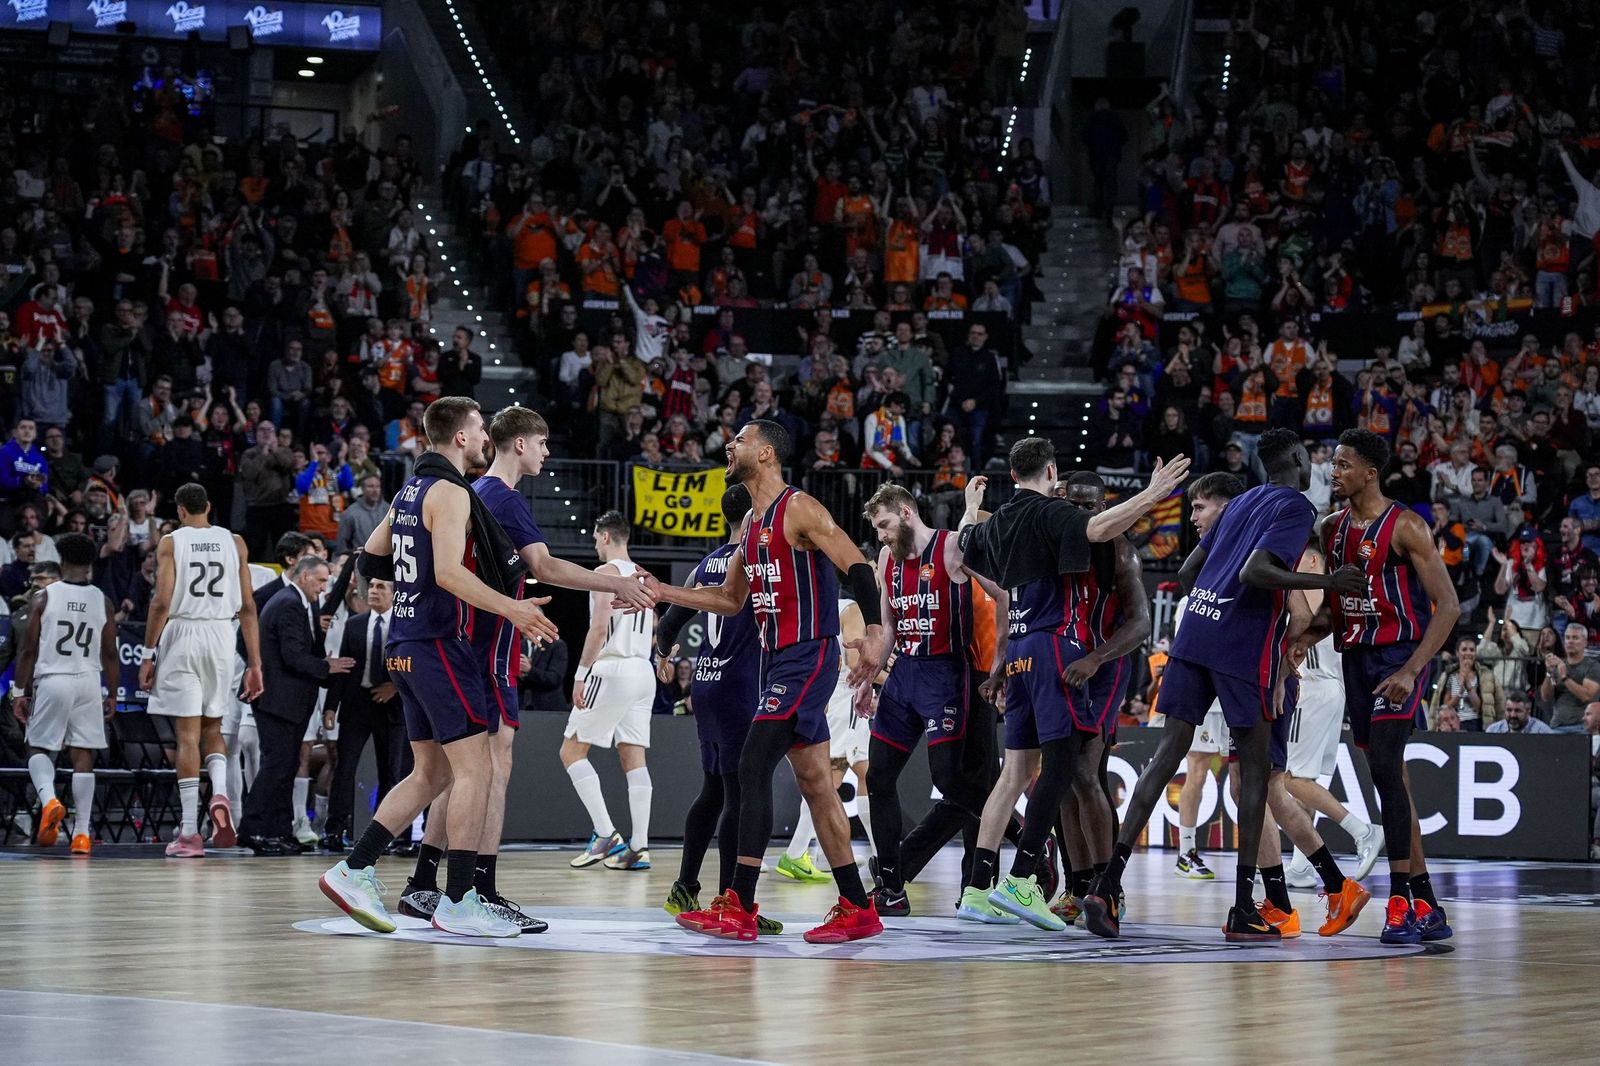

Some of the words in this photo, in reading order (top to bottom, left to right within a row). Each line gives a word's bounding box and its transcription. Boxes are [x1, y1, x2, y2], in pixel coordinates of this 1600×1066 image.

[652, 474, 707, 492] LIM
[640, 509, 721, 532] HOME
[190, 543, 221, 553] TAVARES
[705, 557, 730, 573] HOW
[189, 561, 225, 598] 22
[751, 592, 779, 608] sner
[1190, 586, 1217, 603] araba
[67, 602, 87, 613] FELIZ
[1188, 598, 1222, 621] álava
[56, 620, 93, 657] 24
